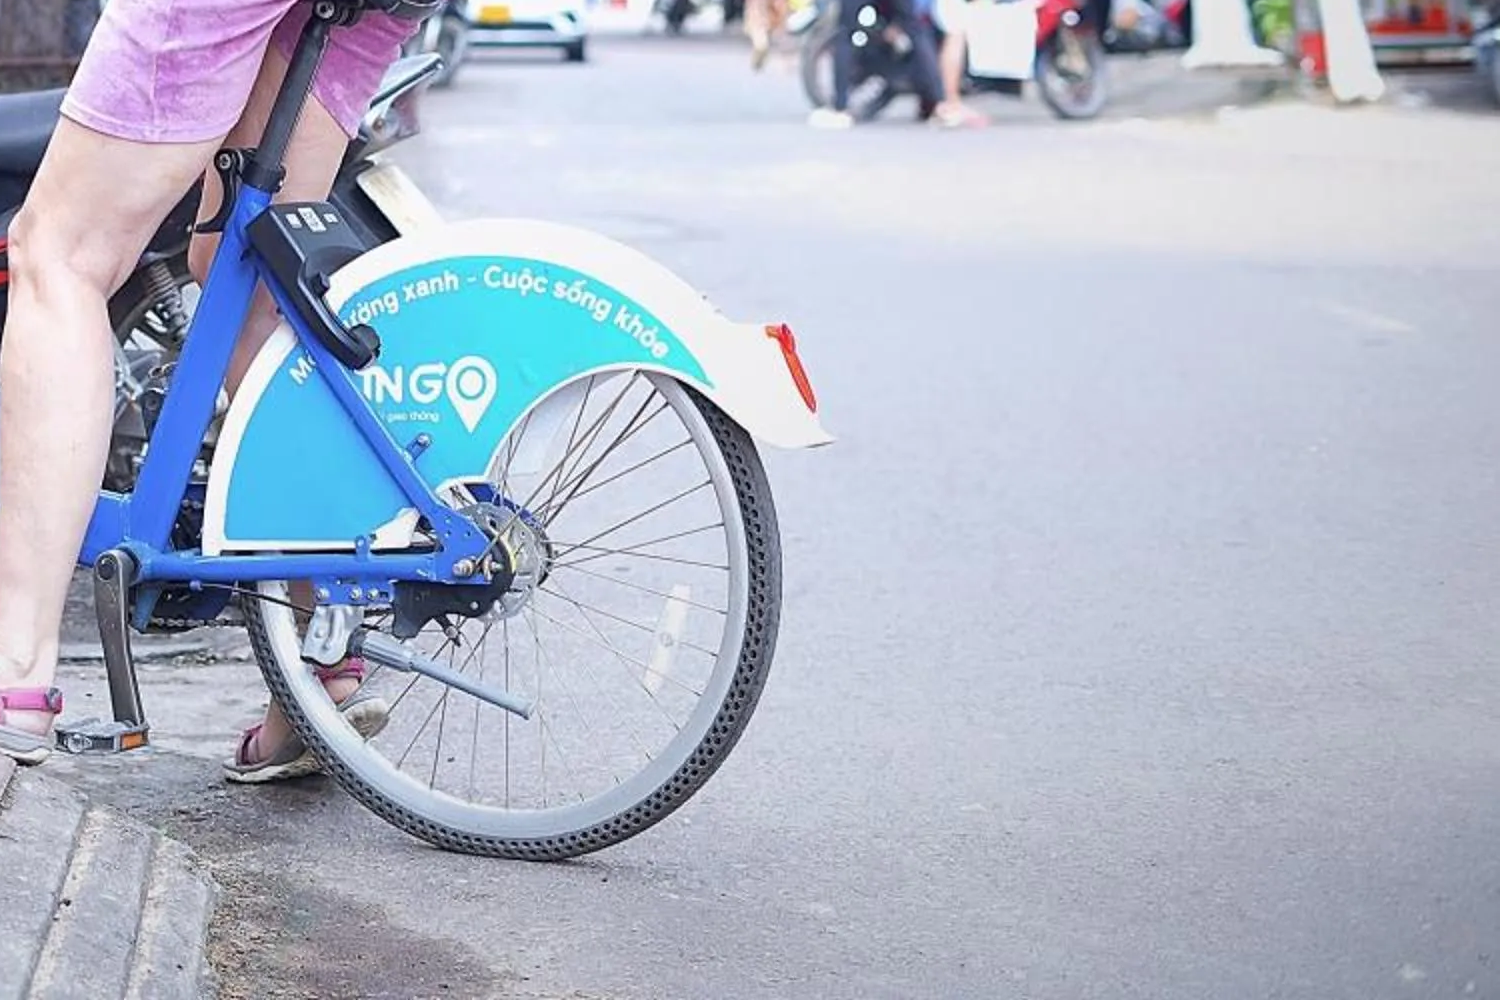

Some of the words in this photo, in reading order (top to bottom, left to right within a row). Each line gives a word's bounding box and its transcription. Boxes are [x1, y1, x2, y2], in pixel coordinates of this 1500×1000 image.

[402, 270, 460, 302] xanh
[484, 265, 548, 297] Cuộc
[553, 279, 613, 322] sống
[614, 305, 669, 359] khỏe
